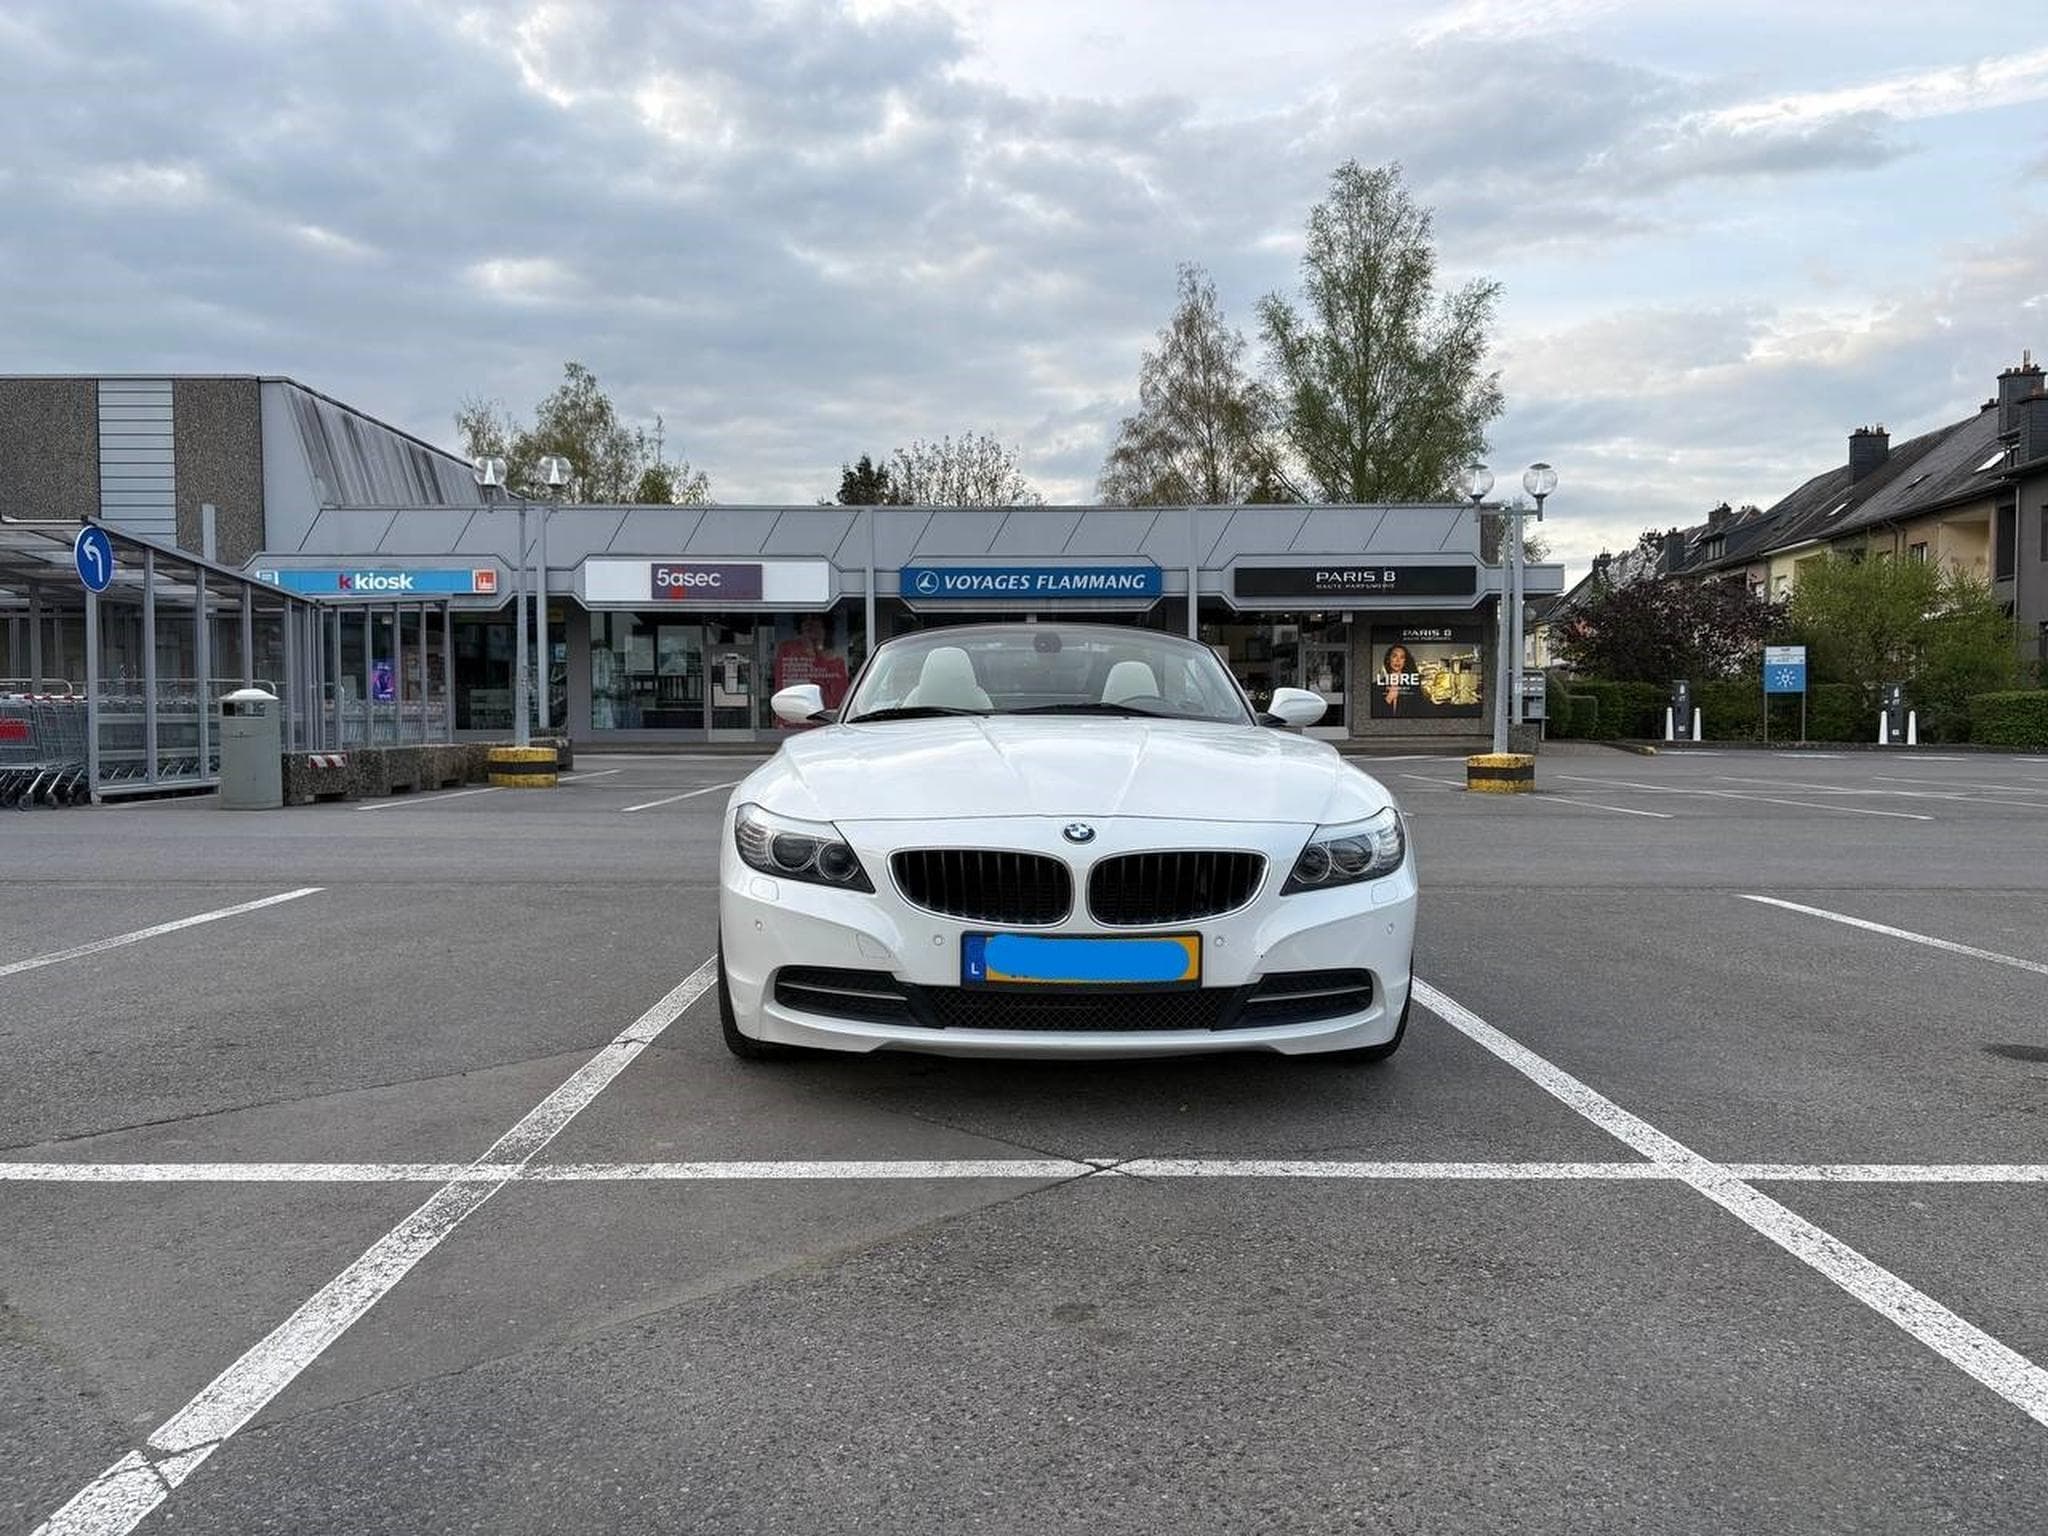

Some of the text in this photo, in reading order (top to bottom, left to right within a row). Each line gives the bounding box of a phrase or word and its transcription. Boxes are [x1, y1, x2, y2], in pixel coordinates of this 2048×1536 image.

[354, 572, 415, 591] kiosk
[655, 568, 722, 588] 5asec
[944, 574, 1146, 590] VOYAGES FLAMMANG
[1315, 570, 1397, 583] PARIS 8
[1376, 673, 1420, 686] LIBRE
[971, 962, 980, 975] L
